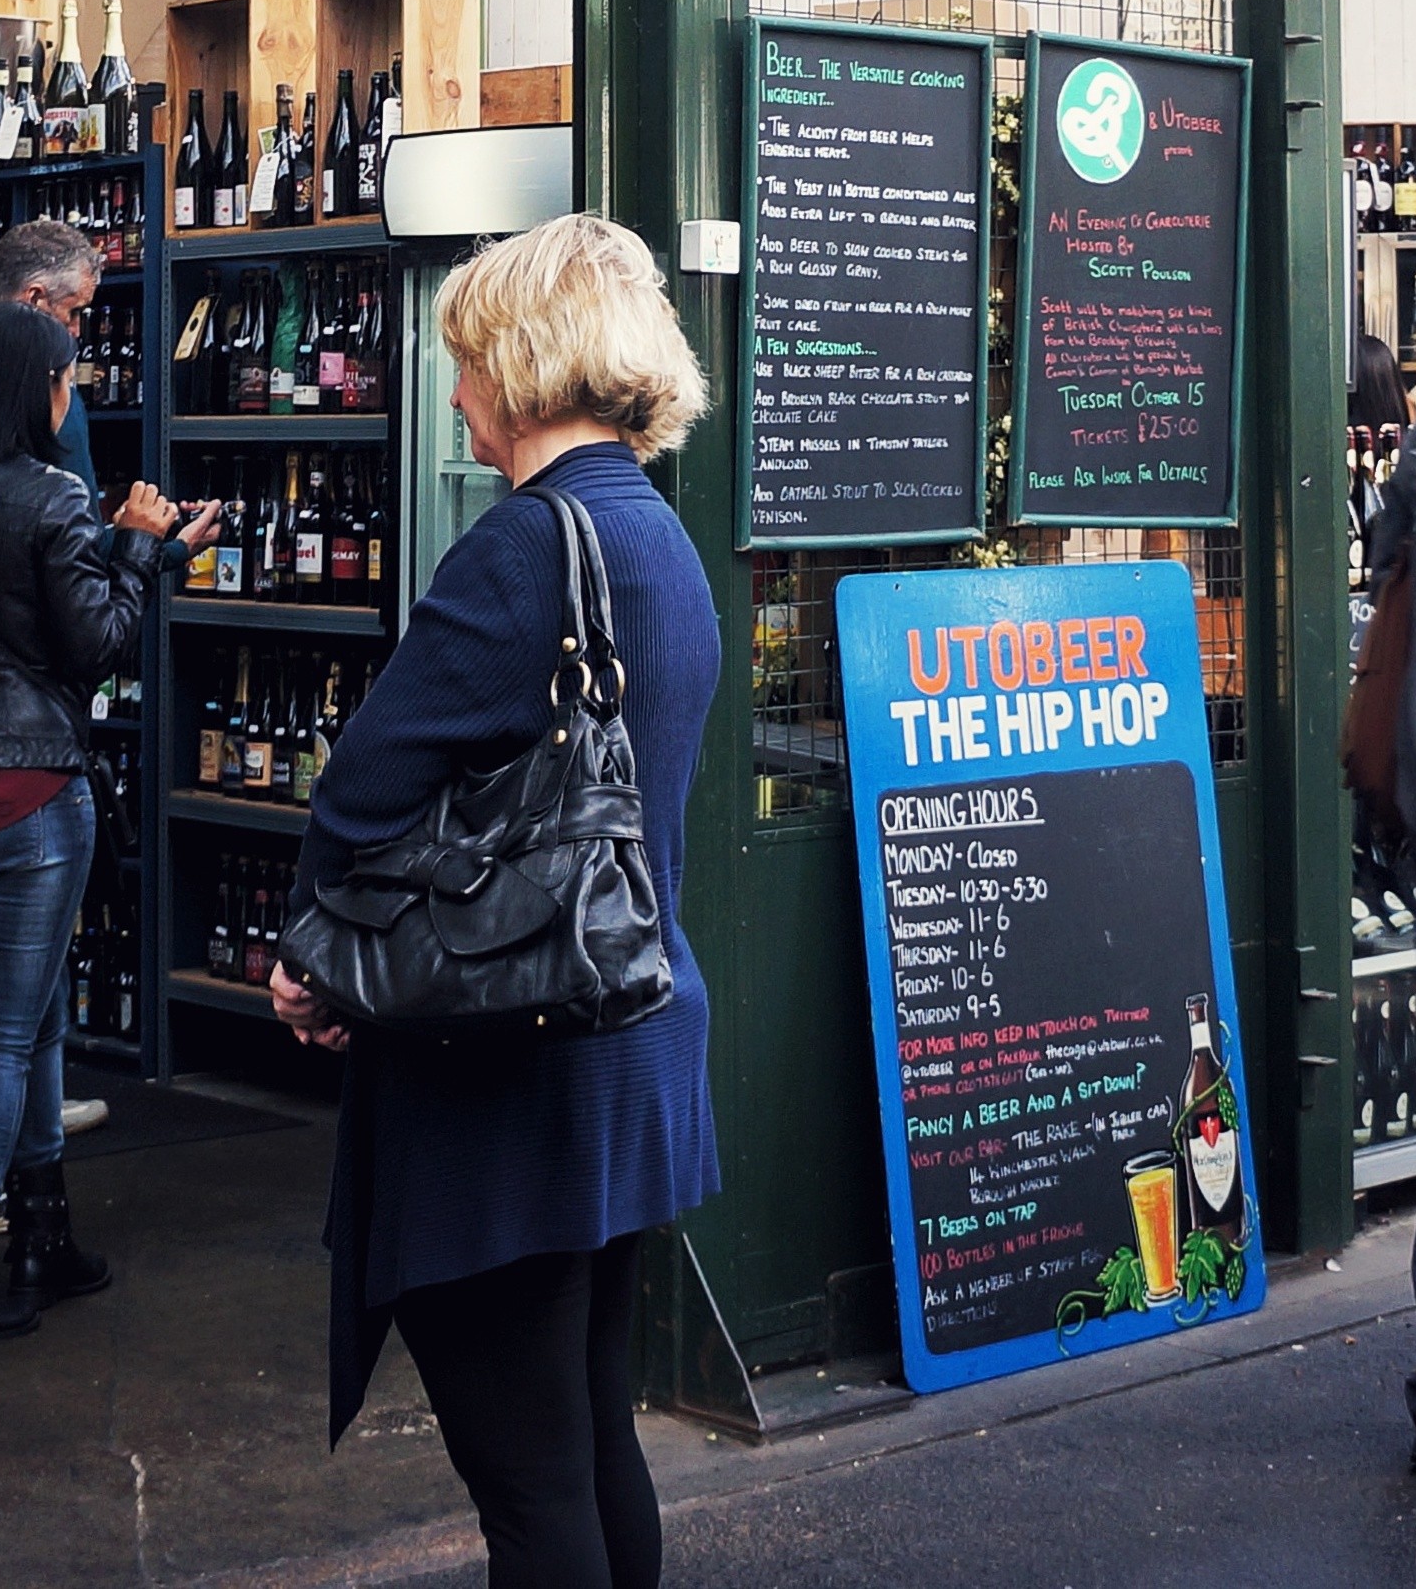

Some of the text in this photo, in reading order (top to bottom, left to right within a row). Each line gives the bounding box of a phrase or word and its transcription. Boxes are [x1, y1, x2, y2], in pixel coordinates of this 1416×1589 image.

[819, 59, 841, 80] THE
[849, 61, 904, 84] VERSATILE
[910, 71, 964, 89] COOKING
[767, 116, 790, 137] THE
[841, 128, 867, 142] FROM
[870, 130, 897, 144] BEER
[902, 131, 933, 146] HELPS
[1161, 98, 1222, 134] UTOBEER
[1049, 209, 1068, 232] AN
[1078, 209, 1126, 231] EVENING
[1066, 235, 1134, 255] HOSTED BY
[1089, 257, 1191, 281] SCOTT POULSON
[754, 336, 762, 355] A
[768, 338, 788, 355] FEW
[1057, 381, 1205, 414] TUESDAY OCTOBER 15
[1071, 428, 1129, 446] TICKETS
[1029, 461, 1207, 489] PLEASE ASK INSIDE FOR DETAILS
[906, 616, 1148, 695] UTOBEER
[890, 682, 1168, 766] THE HIP HOP
[881, 787, 1038, 832] OPENING HOURS
[897, 1002, 960, 1027] SATURDAY
[898, 1008, 1150, 1062] FOR MORE INFO KEEP IN TOUCH ON TWITTER
[907, 1062, 1146, 1141] FANCY A BEER AND A SIT DOWN?
[919, 1202, 1037, 1245] 7 BEERS ON TAP
